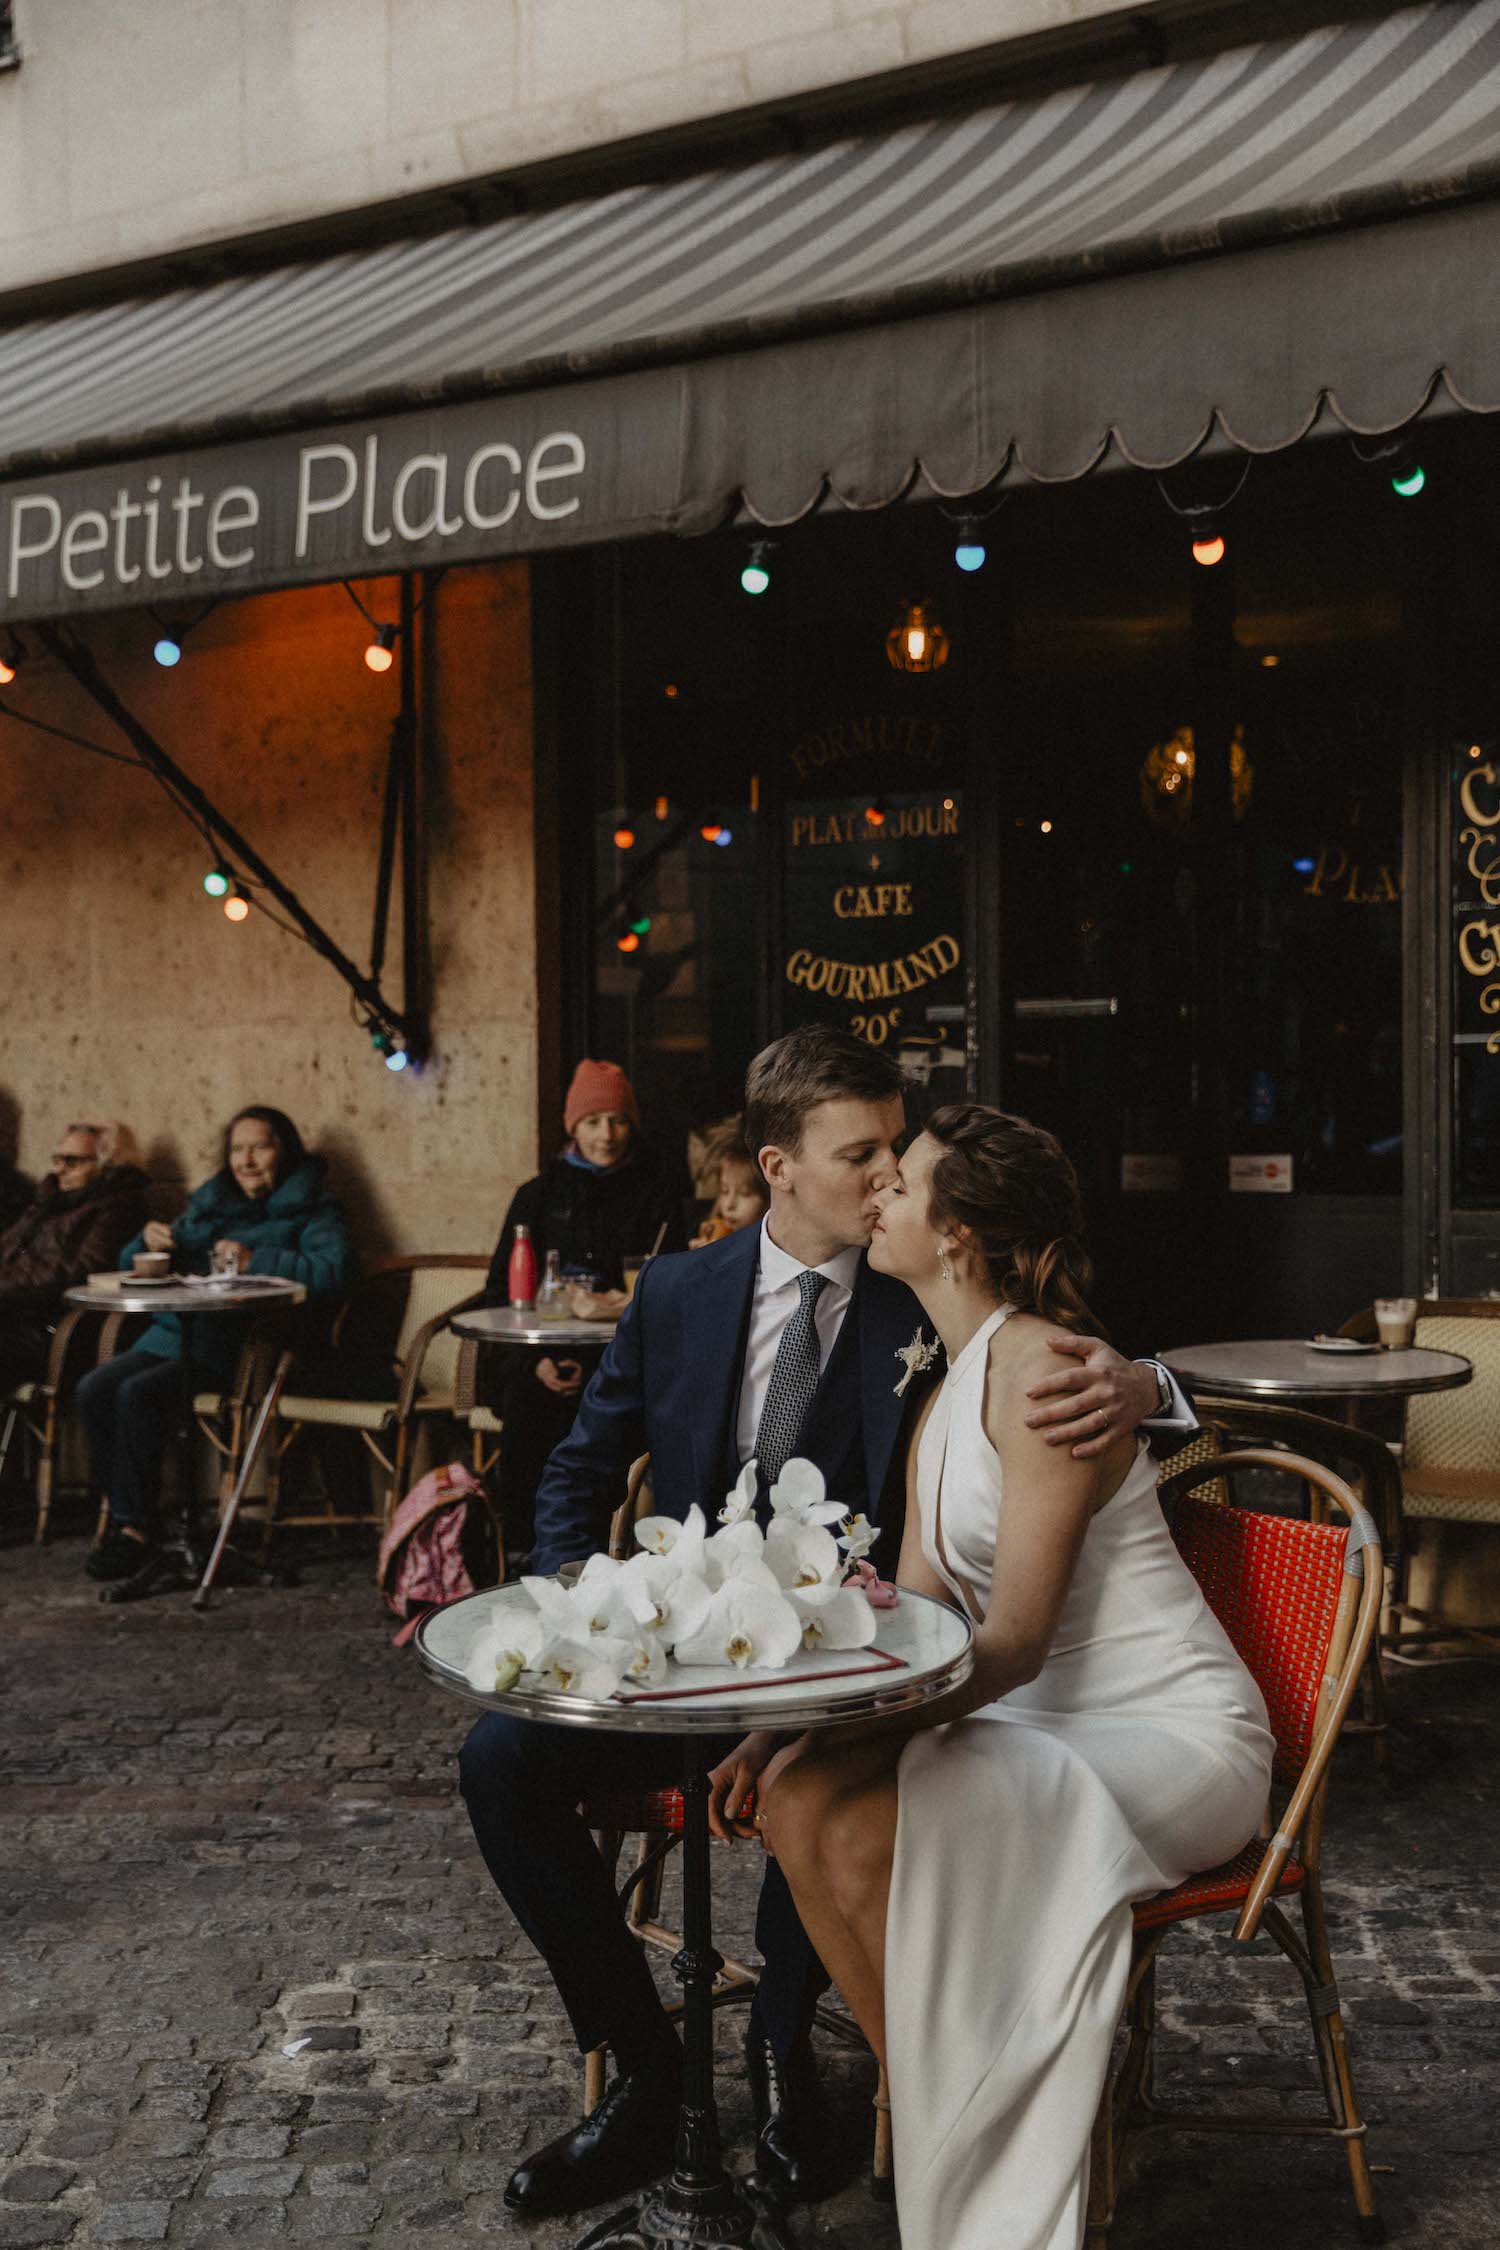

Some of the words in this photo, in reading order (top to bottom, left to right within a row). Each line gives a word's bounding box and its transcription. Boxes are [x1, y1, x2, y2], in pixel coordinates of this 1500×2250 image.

[8, 475, 260, 598] Petite
[294, 431, 587, 557] Place
[791, 812, 859, 847] PLAT
[890, 803, 960, 840] JOUR
[833, 882, 913, 920] CAFE
[785, 933, 962, 1003] GOURMAND
